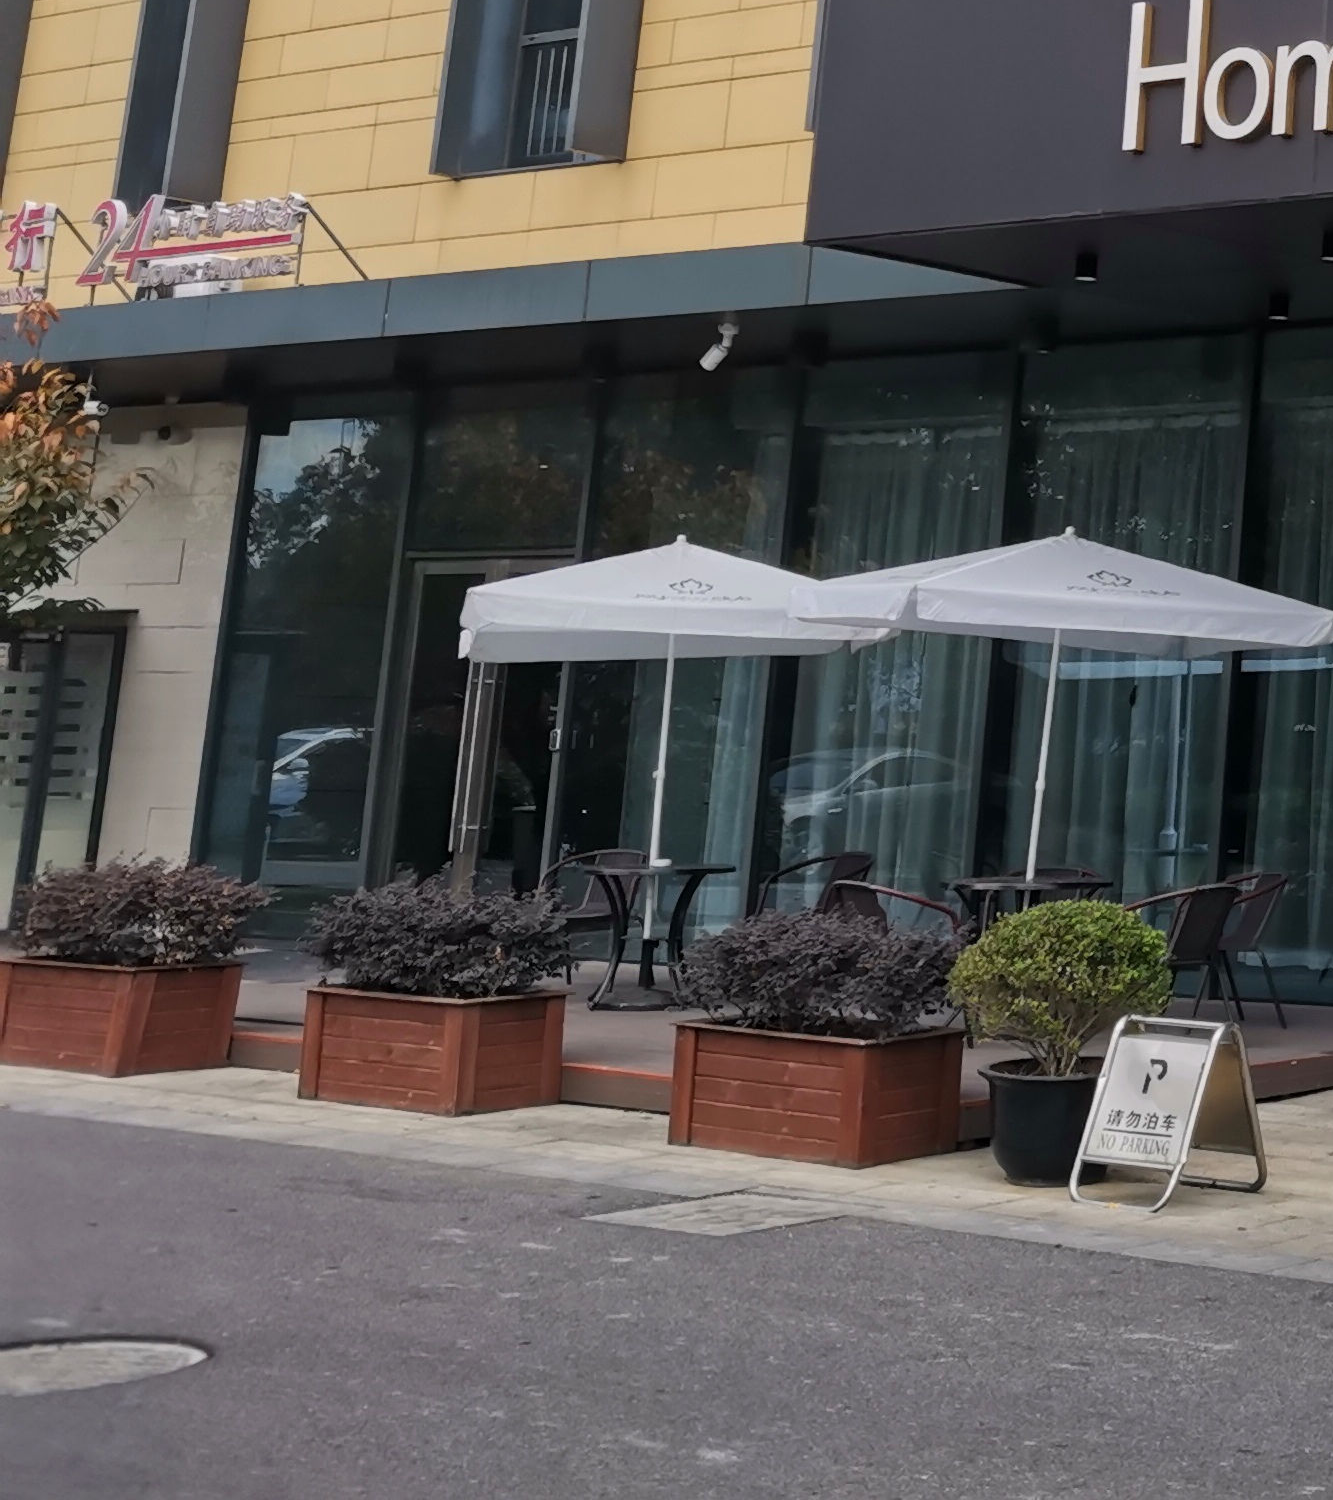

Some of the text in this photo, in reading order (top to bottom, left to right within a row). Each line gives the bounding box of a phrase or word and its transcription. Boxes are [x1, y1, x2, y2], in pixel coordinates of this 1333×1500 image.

[76, 194, 165, 287] 24
[1106, 1109, 1178, 1132] 请勿泊车
[1096, 1133, 1171, 1158] NO PARKING
